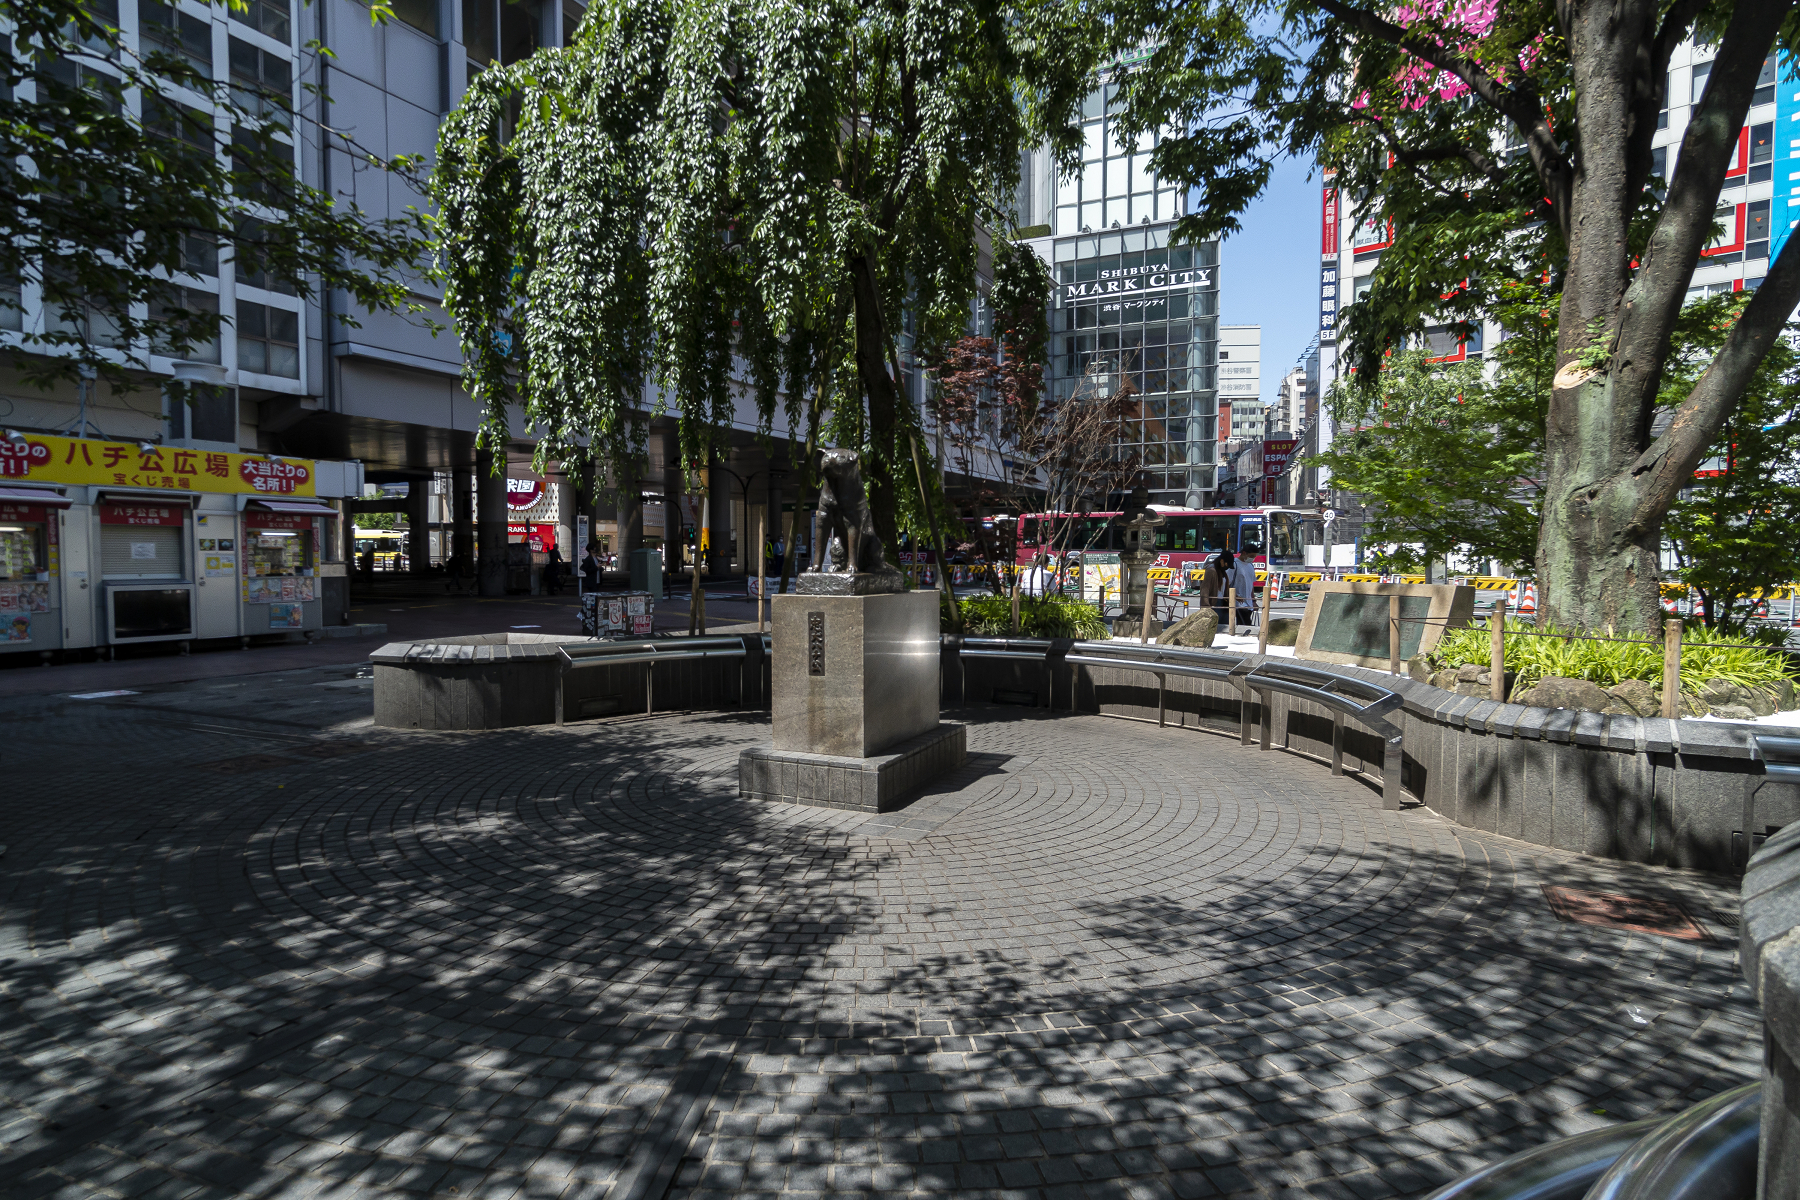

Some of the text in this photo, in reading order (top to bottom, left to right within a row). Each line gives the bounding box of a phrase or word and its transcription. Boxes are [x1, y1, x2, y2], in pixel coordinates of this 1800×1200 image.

[1101, 263, 1169, 279] SHIBUYA
[1067, 269, 1212, 298] MARK CITY
[1322, 270, 1336, 328] 加藤眼科
[1322, 331, 1334, 339] 5F
[65, 442, 229, 478] ハチ公広場
[243, 461, 307, 478] 大当たりの
[113, 473, 191, 489] 宝くじ売場
[810, 615, 823, 673] 忠犬ハチ公
